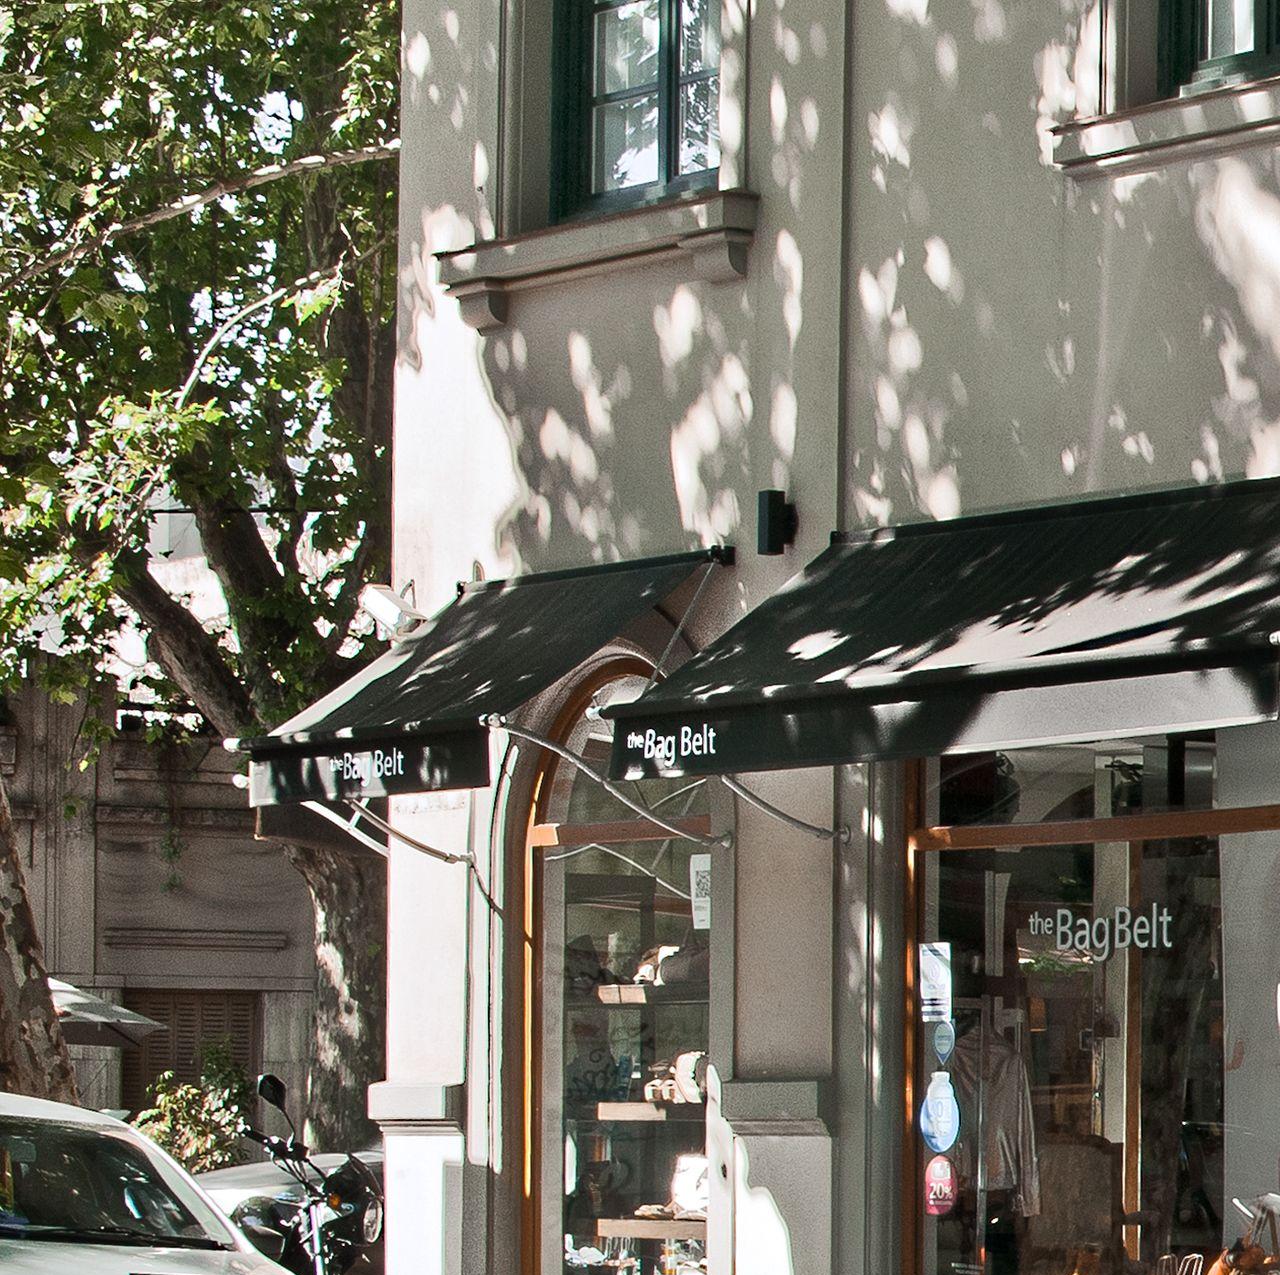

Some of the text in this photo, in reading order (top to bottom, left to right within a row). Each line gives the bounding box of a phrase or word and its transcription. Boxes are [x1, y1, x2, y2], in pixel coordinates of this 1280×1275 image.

[343, 752, 371, 787] Bag
[374, 747, 405, 778] Belt
[627, 723, 717, 767] the Bag Belt
[1028, 902, 1173, 962] the Bag Belt
